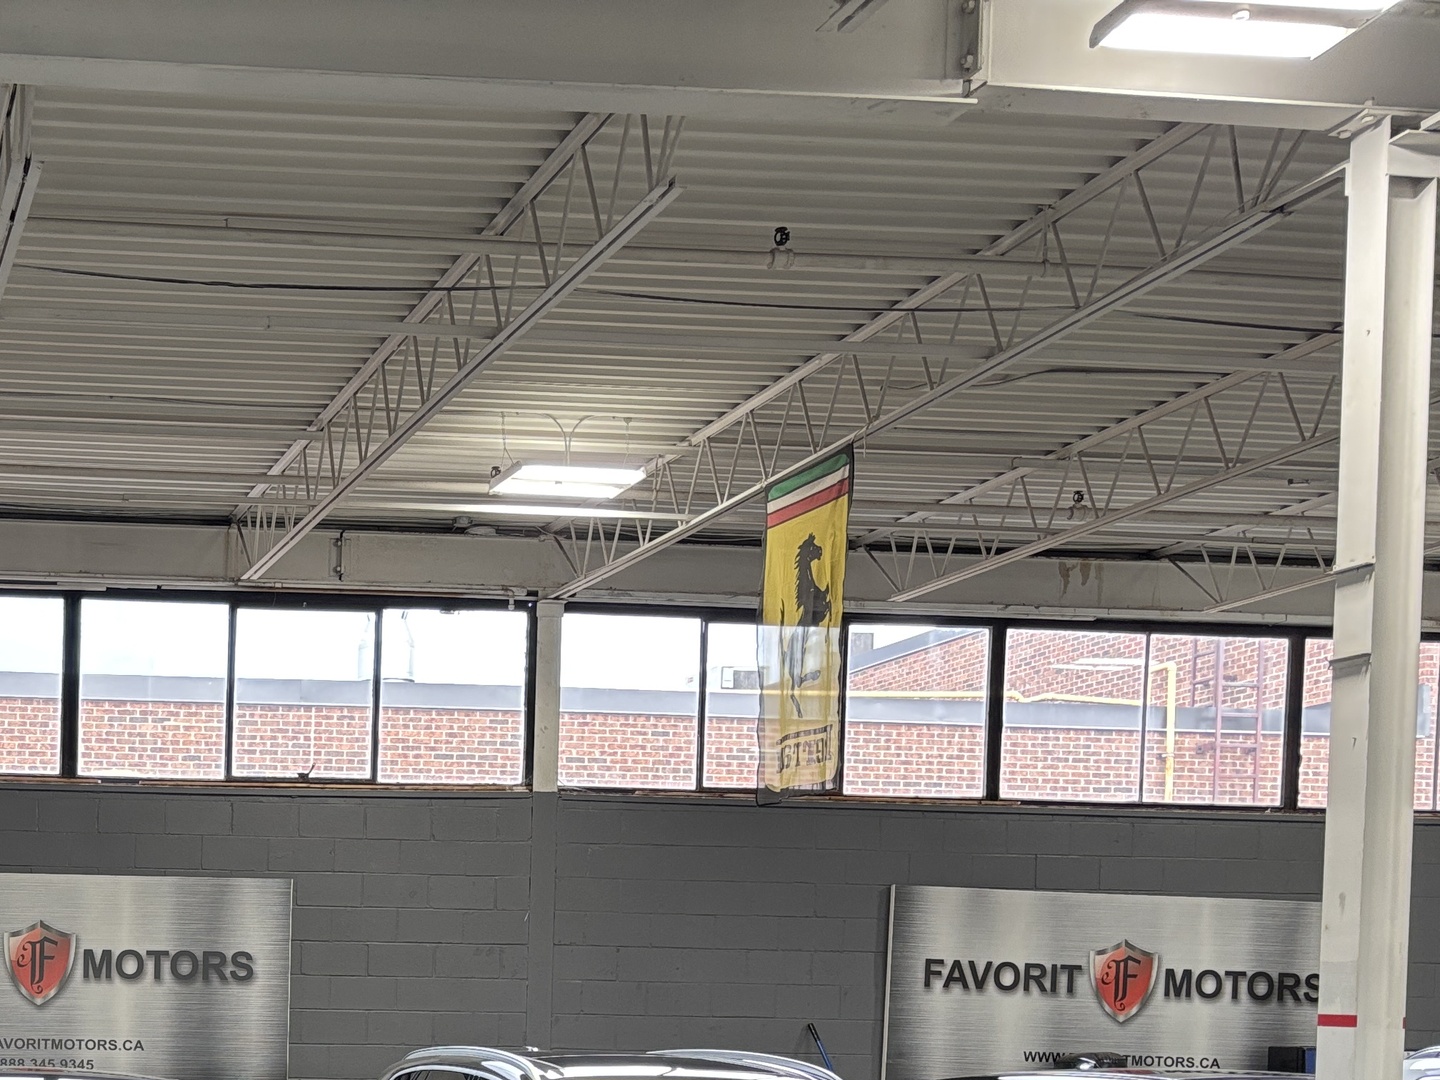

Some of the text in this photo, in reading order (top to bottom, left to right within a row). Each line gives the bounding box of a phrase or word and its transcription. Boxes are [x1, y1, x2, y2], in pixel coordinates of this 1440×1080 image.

[82, 948, 255, 982] MOTORS
[923, 957, 1320, 1003] FAVORIT MOTORS
